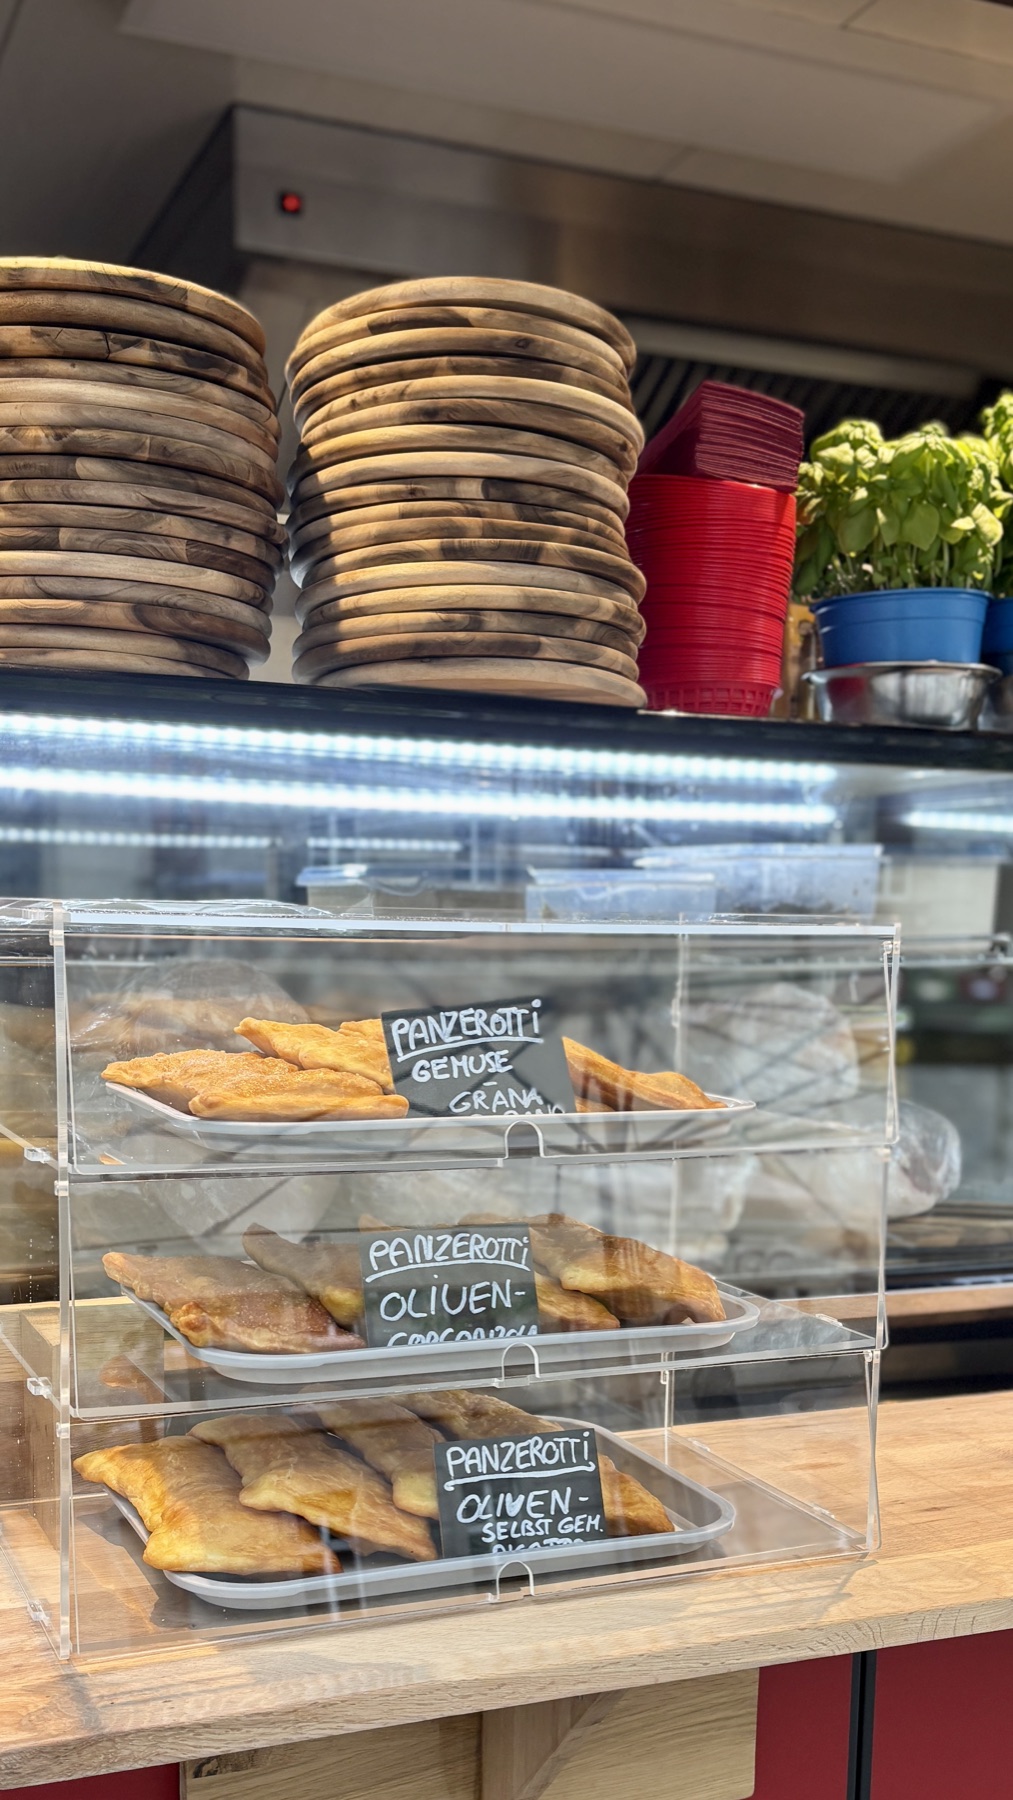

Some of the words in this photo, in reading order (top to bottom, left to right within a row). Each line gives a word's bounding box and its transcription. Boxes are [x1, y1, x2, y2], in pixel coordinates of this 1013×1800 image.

[411, 1049, 513, 1082] GEMUSE
[449, 1087, 543, 1114] GRANA
[481, 1518, 553, 1543] SELBST
